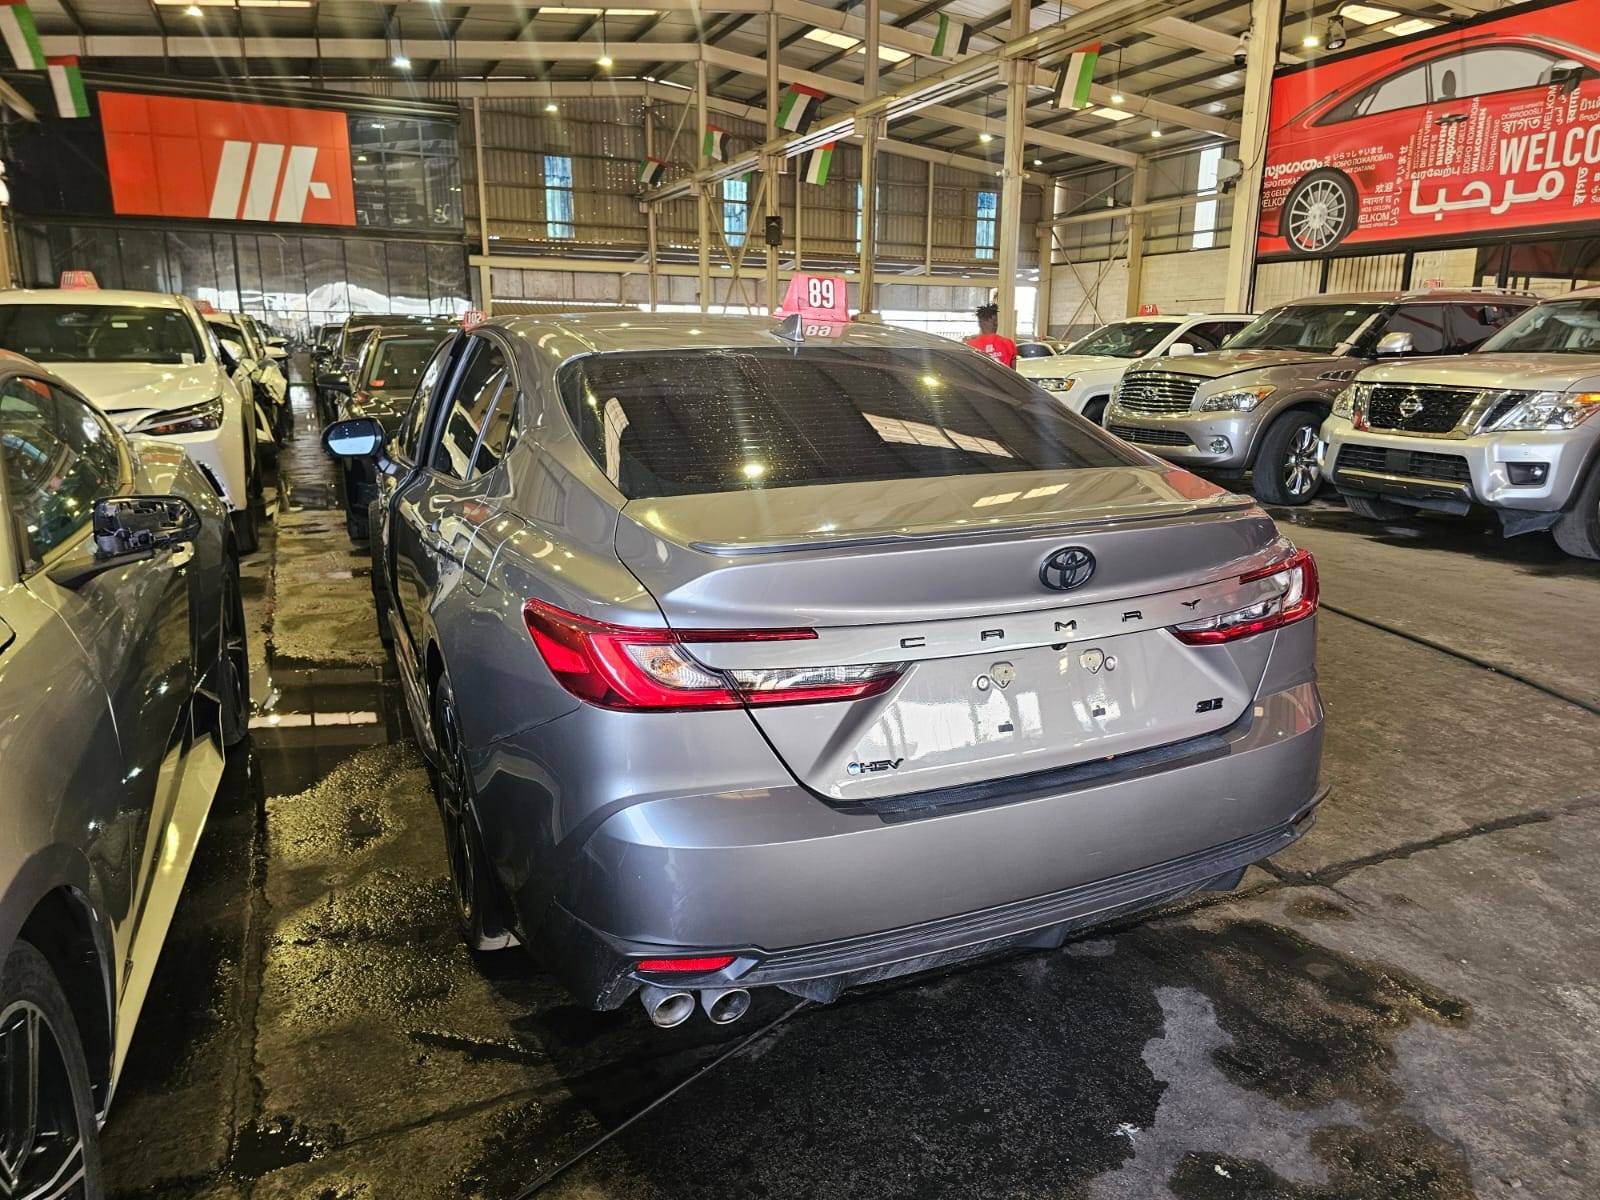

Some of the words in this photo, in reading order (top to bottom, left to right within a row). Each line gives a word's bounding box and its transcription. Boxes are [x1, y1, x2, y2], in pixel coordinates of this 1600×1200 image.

[1471, 107, 1487, 173] WILLKOMMEN
[1408, 170, 1565, 220] مرحبا
[808, 278, 834, 309] 89
[900, 598, 1201, 649] CAMRY
